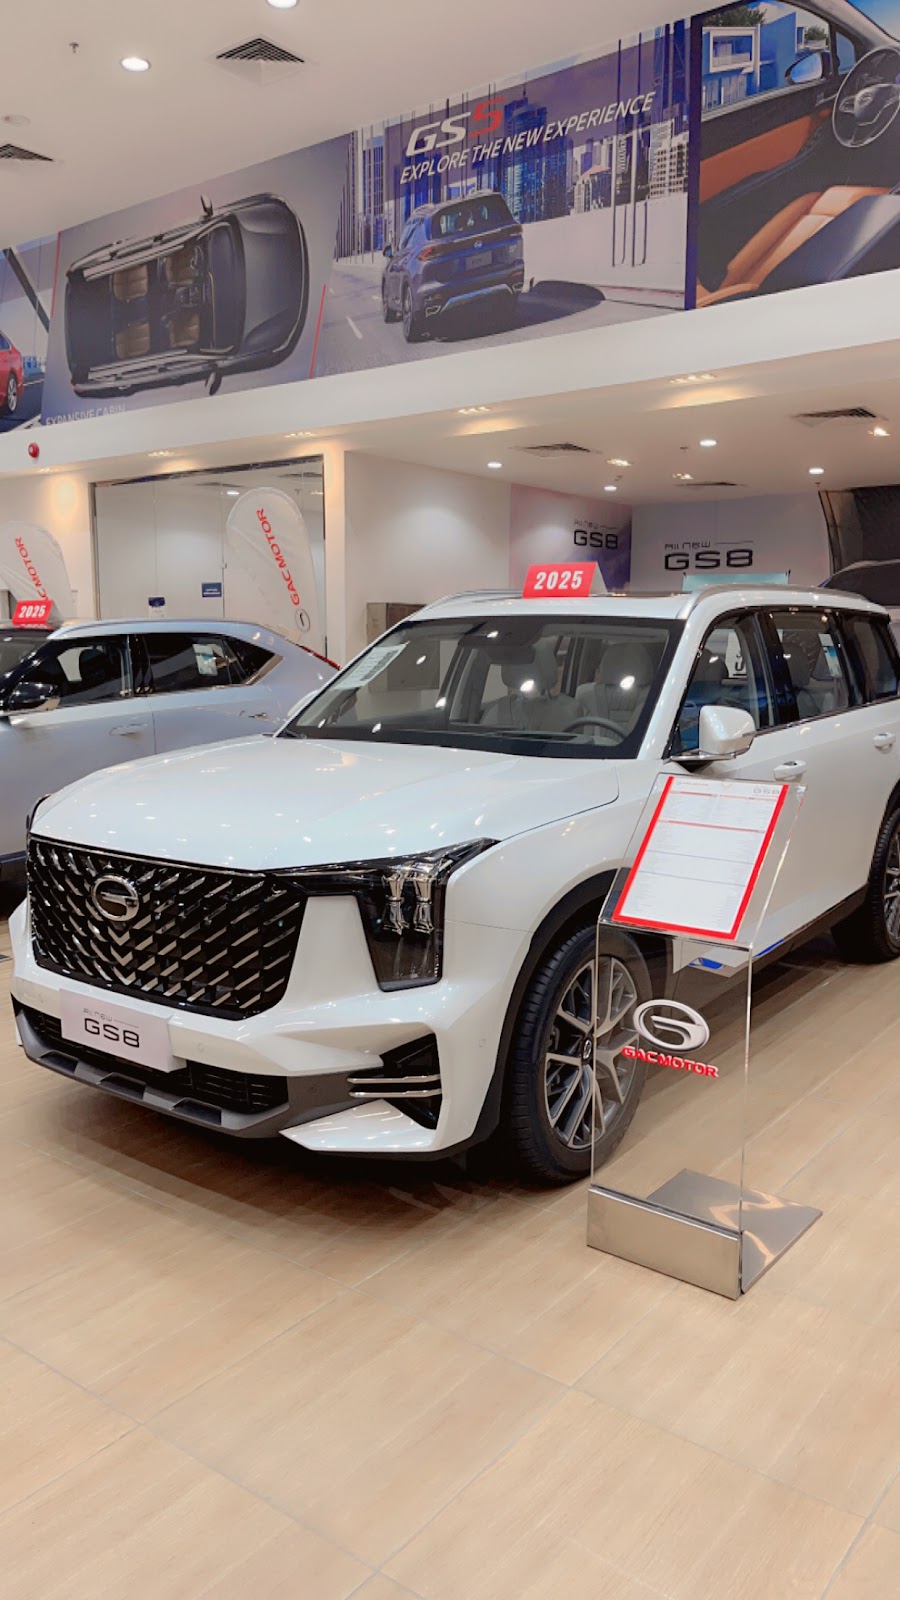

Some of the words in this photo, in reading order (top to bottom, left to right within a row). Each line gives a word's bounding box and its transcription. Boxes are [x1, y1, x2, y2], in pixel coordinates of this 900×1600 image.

[400, 148, 470, 184] EXPLORE
[471, 138, 503, 163] THE
[501, 126, 543, 154] NEW
[542, 91, 656, 143] EXPERIENCE
[405, 97, 505, 157] GS5
[256, 508, 286, 569] MOTOR
[573, 529, 618, 550] GS8
[15, 536, 42, 587] MOTOR
[664, 548, 753, 571] GS8
[281, 569, 300, 606] GAC
[534, 570, 584, 590] 2025
[18, 605, 47, 619] 2025
[84, 1018, 140, 1048] GS8
